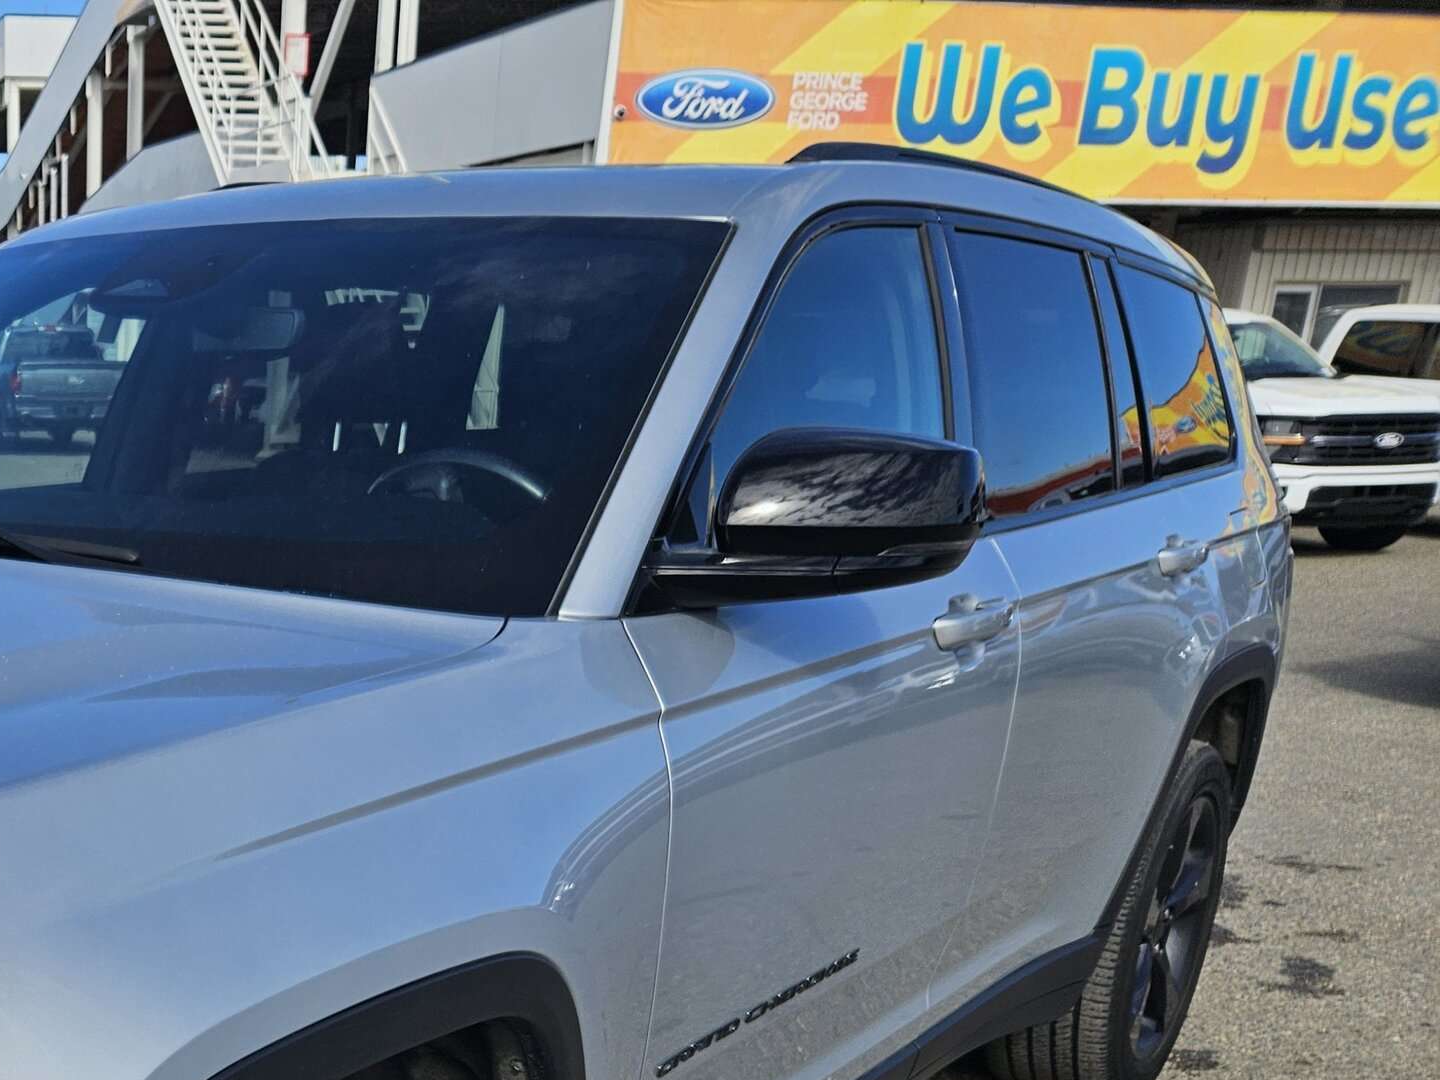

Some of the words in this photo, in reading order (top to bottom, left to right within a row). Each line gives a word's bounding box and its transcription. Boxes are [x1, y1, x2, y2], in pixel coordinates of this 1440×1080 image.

[791, 72, 864, 92] PRINCE
[662, 77, 750, 121] Ford
[788, 91, 869, 111] GEORGE
[896, 43, 1053, 145] We
[1078, 49, 1262, 174] Buy
[1285, 53, 1440, 151] Use
[786, 111, 841, 130] FORD
